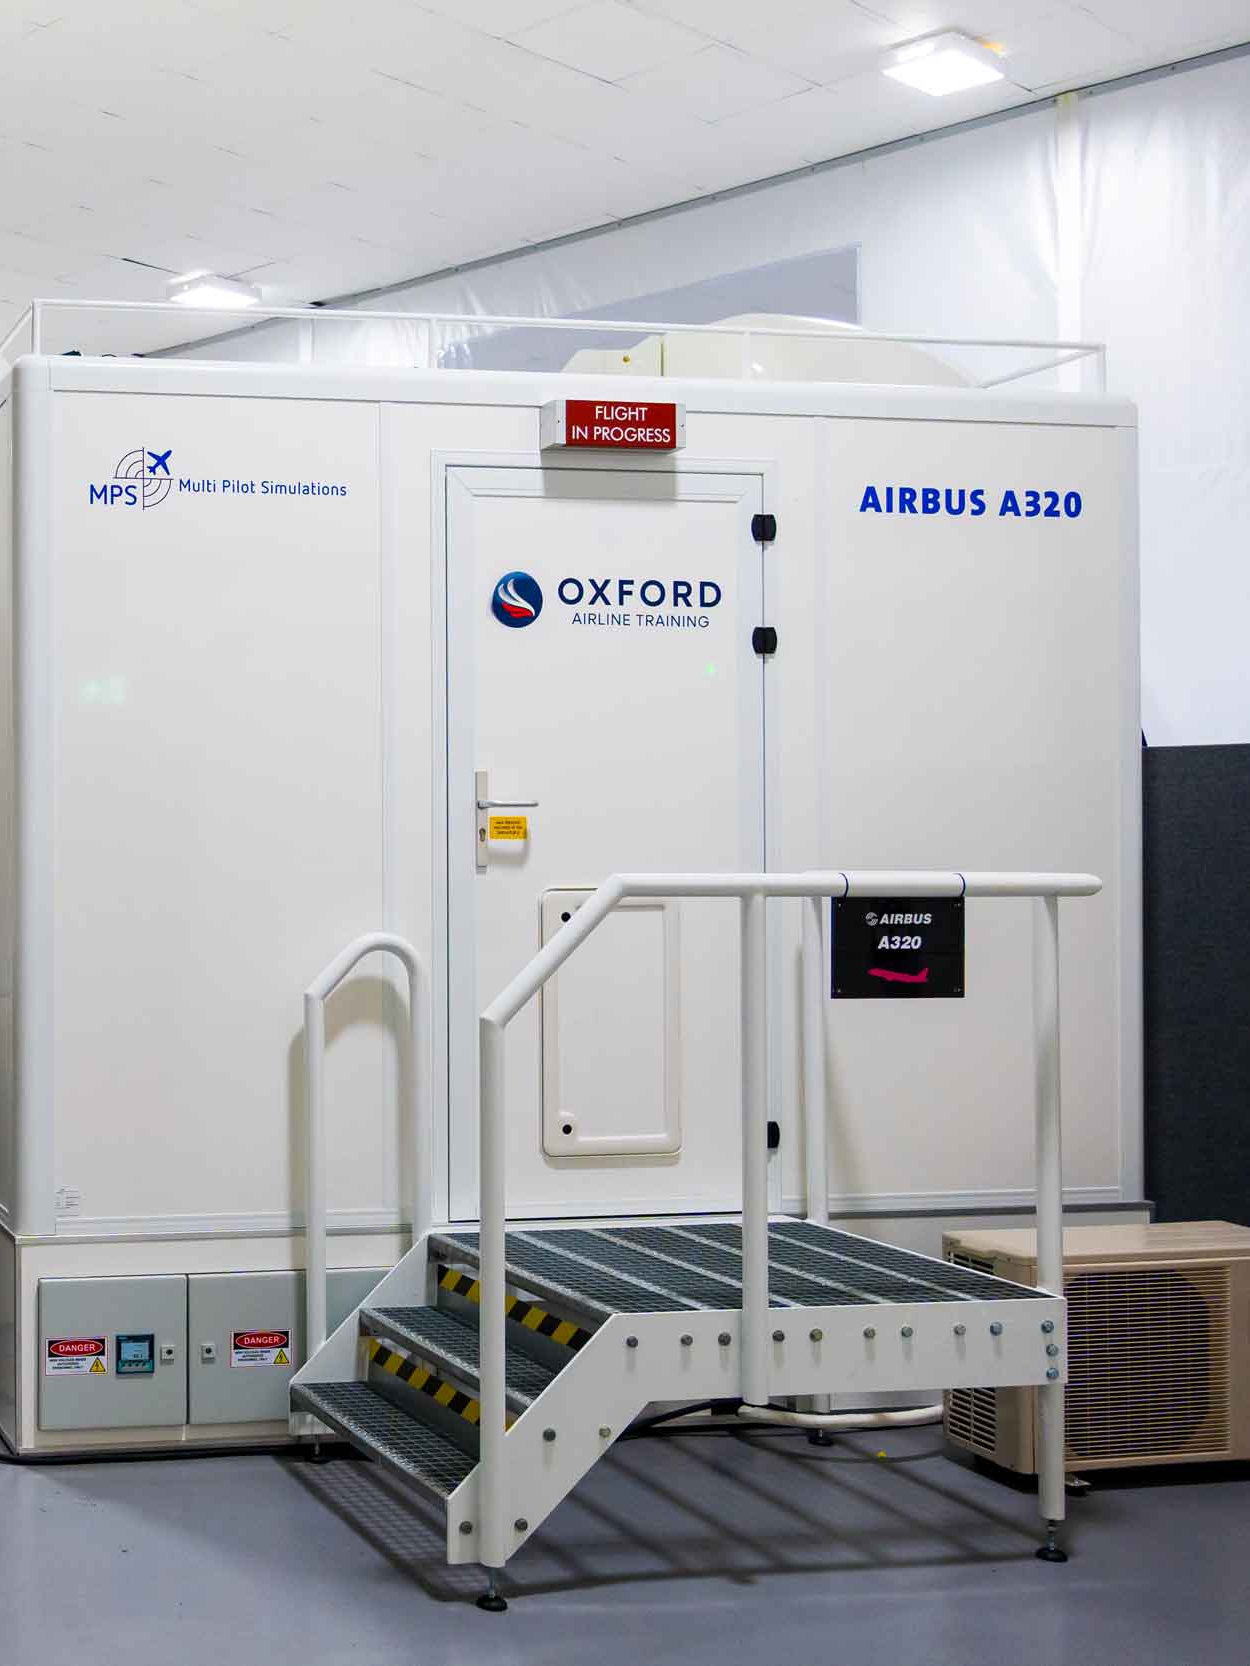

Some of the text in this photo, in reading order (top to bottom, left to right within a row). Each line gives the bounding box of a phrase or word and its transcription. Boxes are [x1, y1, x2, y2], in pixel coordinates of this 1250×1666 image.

[595, 406, 648, 421] FLIGHT
[571, 426, 671, 443] IN PROGRESS
[89, 484, 138, 506] MPS
[178, 479, 347, 496] Multi Pilot Simulations
[859, 486, 1082, 518] AIRBUS A320
[558, 578, 722, 607] OXFORD
[572, 613, 710, 628] AIRLINE TRAINING
[879, 913, 932, 925] AIRBUS
[877, 935, 922, 949] A320
[58, 1343, 96, 1352] DANGER
[244, 1336, 280, 1345] DANGER
